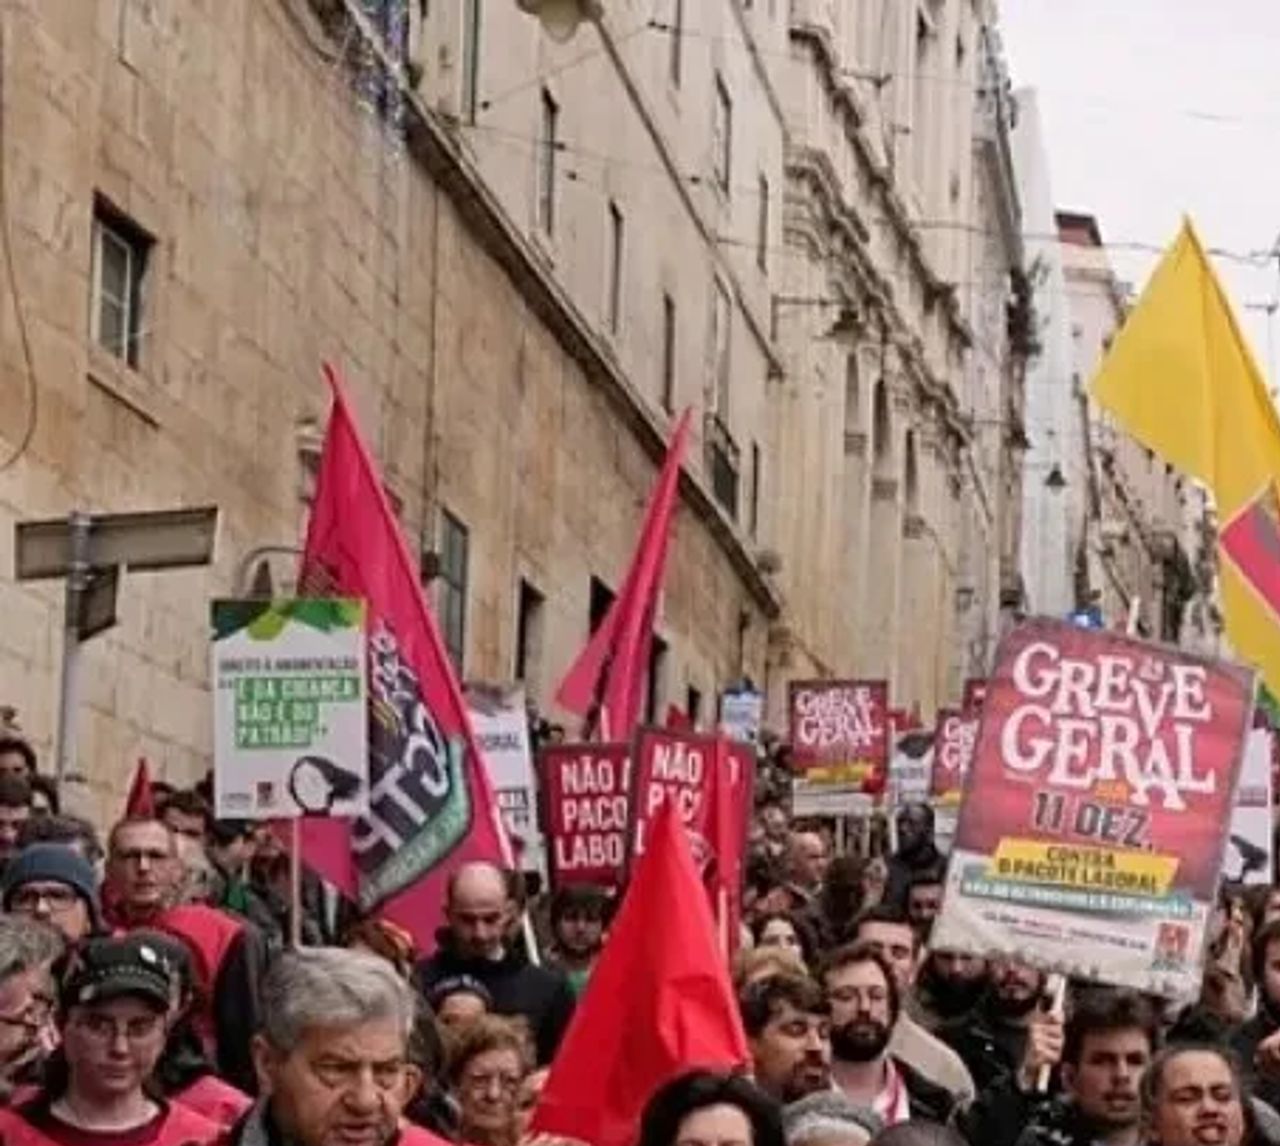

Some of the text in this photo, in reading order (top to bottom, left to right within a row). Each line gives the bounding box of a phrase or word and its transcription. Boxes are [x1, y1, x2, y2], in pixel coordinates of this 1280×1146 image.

[1013, 642, 1211, 740] GREVE
[561, 755, 614, 795] NÃO
[651, 741, 704, 783] NÃO
[1001, 705, 1215, 811] GERAL
[563, 797, 629, 834] PACO
[1035, 791, 1154, 852] 11 DEZ.
[556, 835, 624, 870] LABO
